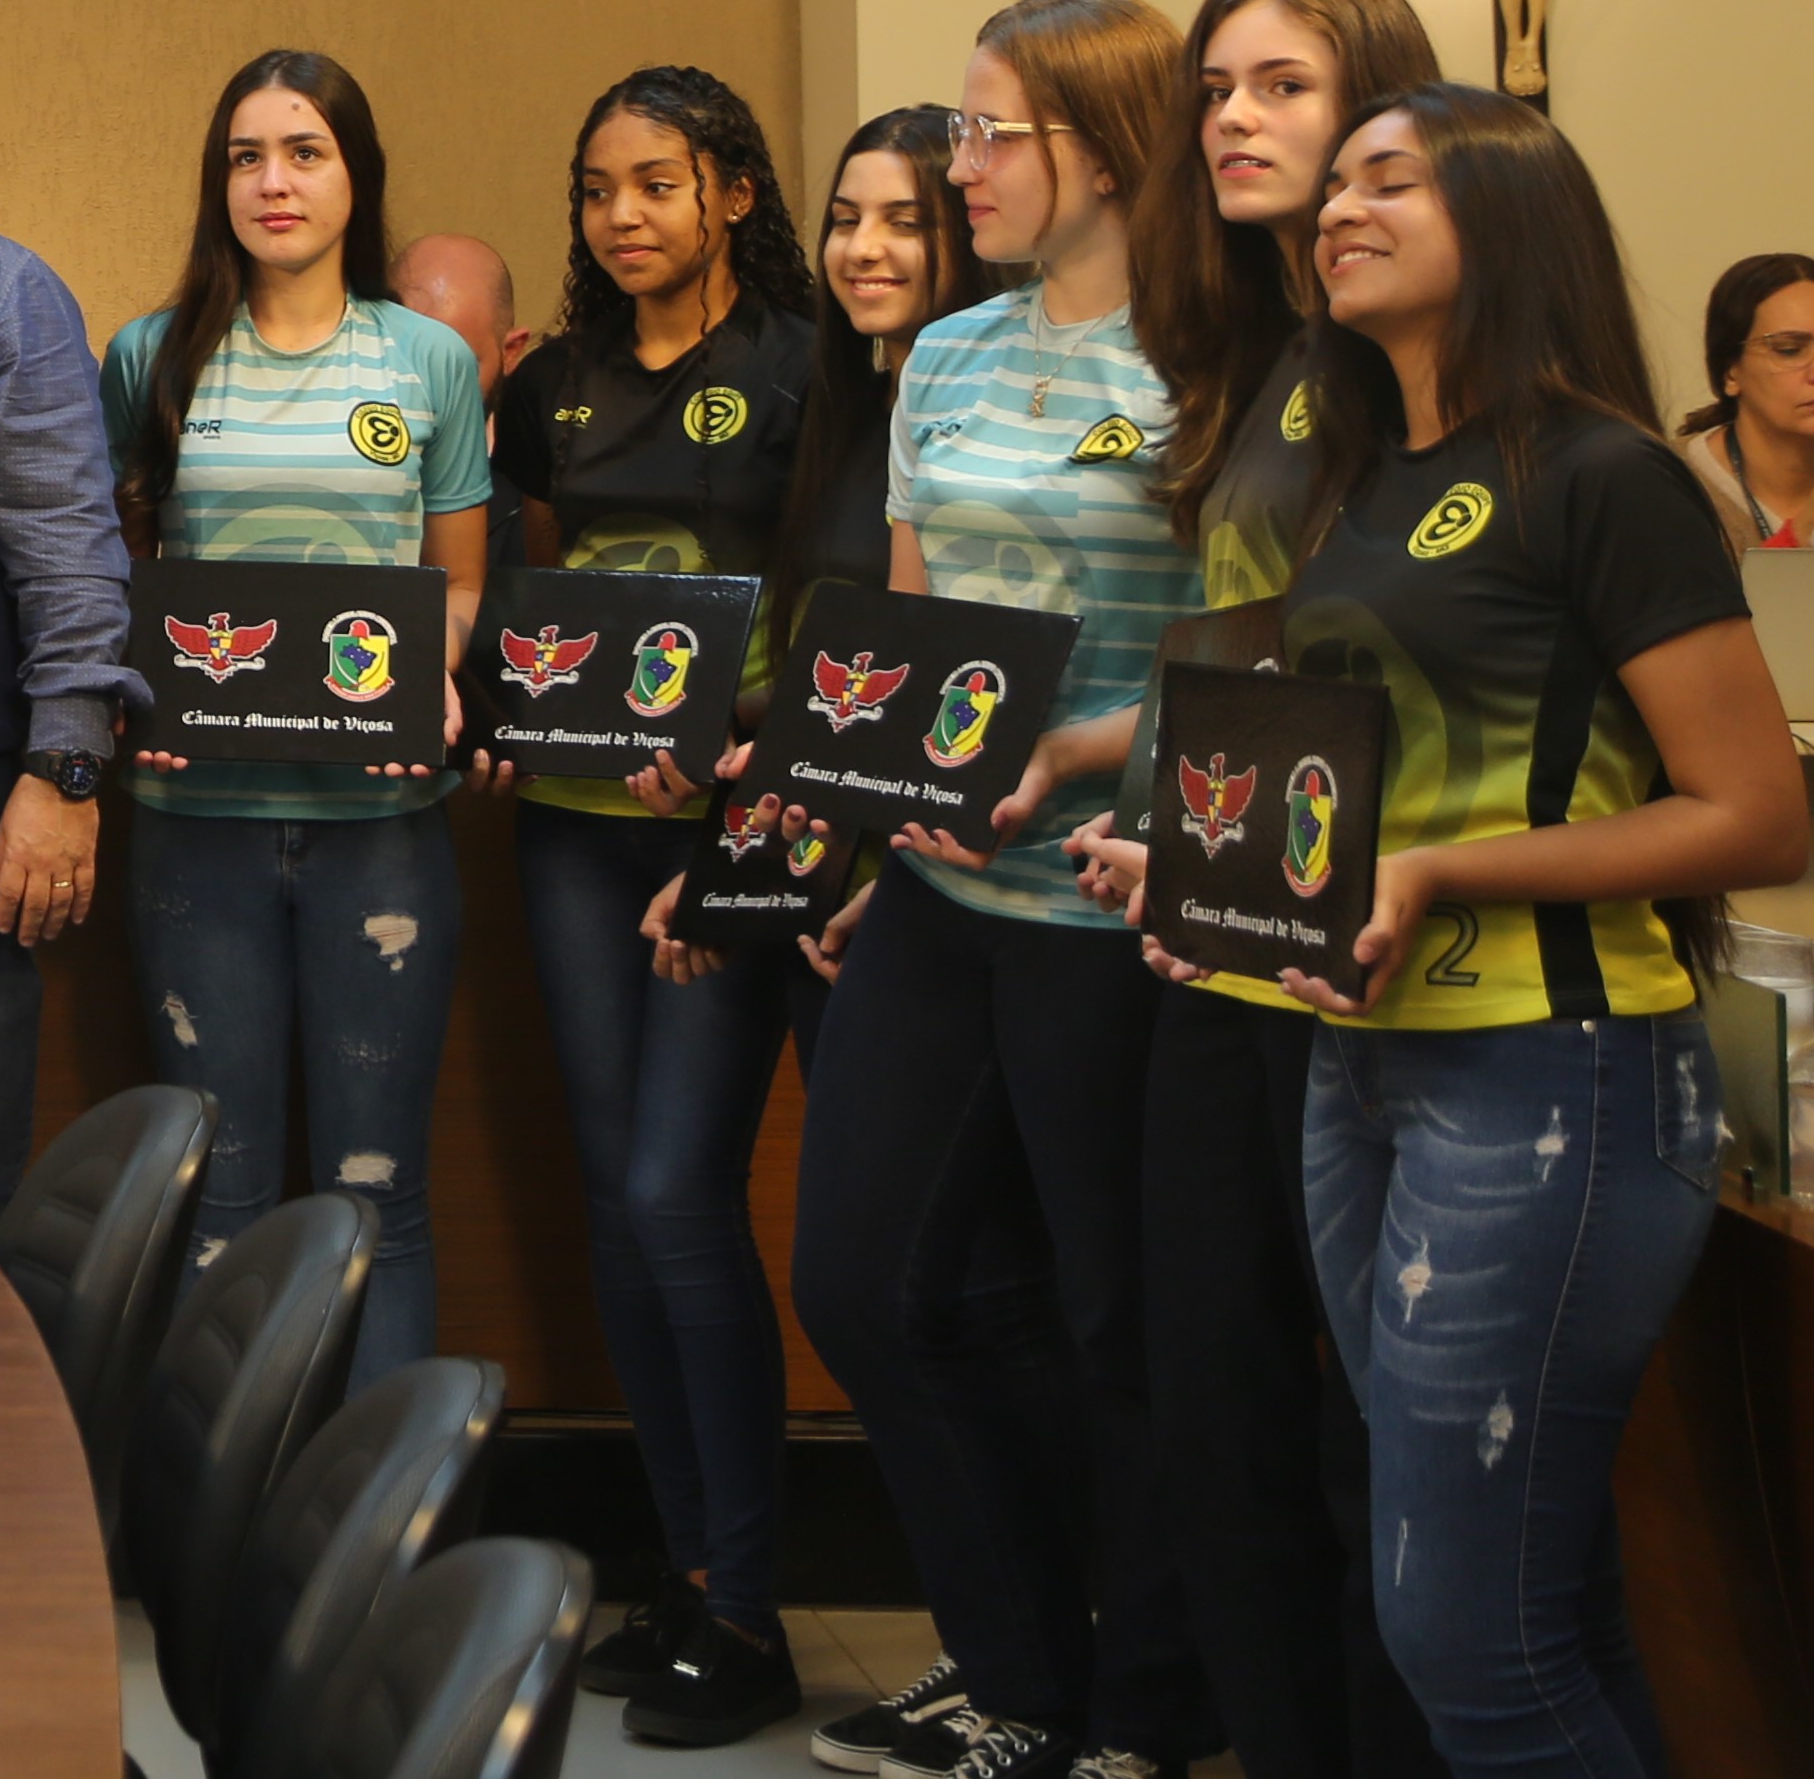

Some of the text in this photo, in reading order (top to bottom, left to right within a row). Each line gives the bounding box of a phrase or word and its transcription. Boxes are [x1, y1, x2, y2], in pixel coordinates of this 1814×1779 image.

[181, 709, 394, 733] Câmara Municipal de Viçosa
[494, 725, 675, 749] Câmara Municipal de Viçosa
[790, 761, 964, 805] Câmara Municipal de Viçosa
[1180, 897, 1221, 925] Câmara
[1222, 906, 1275, 936] Municipal
[1276, 918, 1289, 939] de
